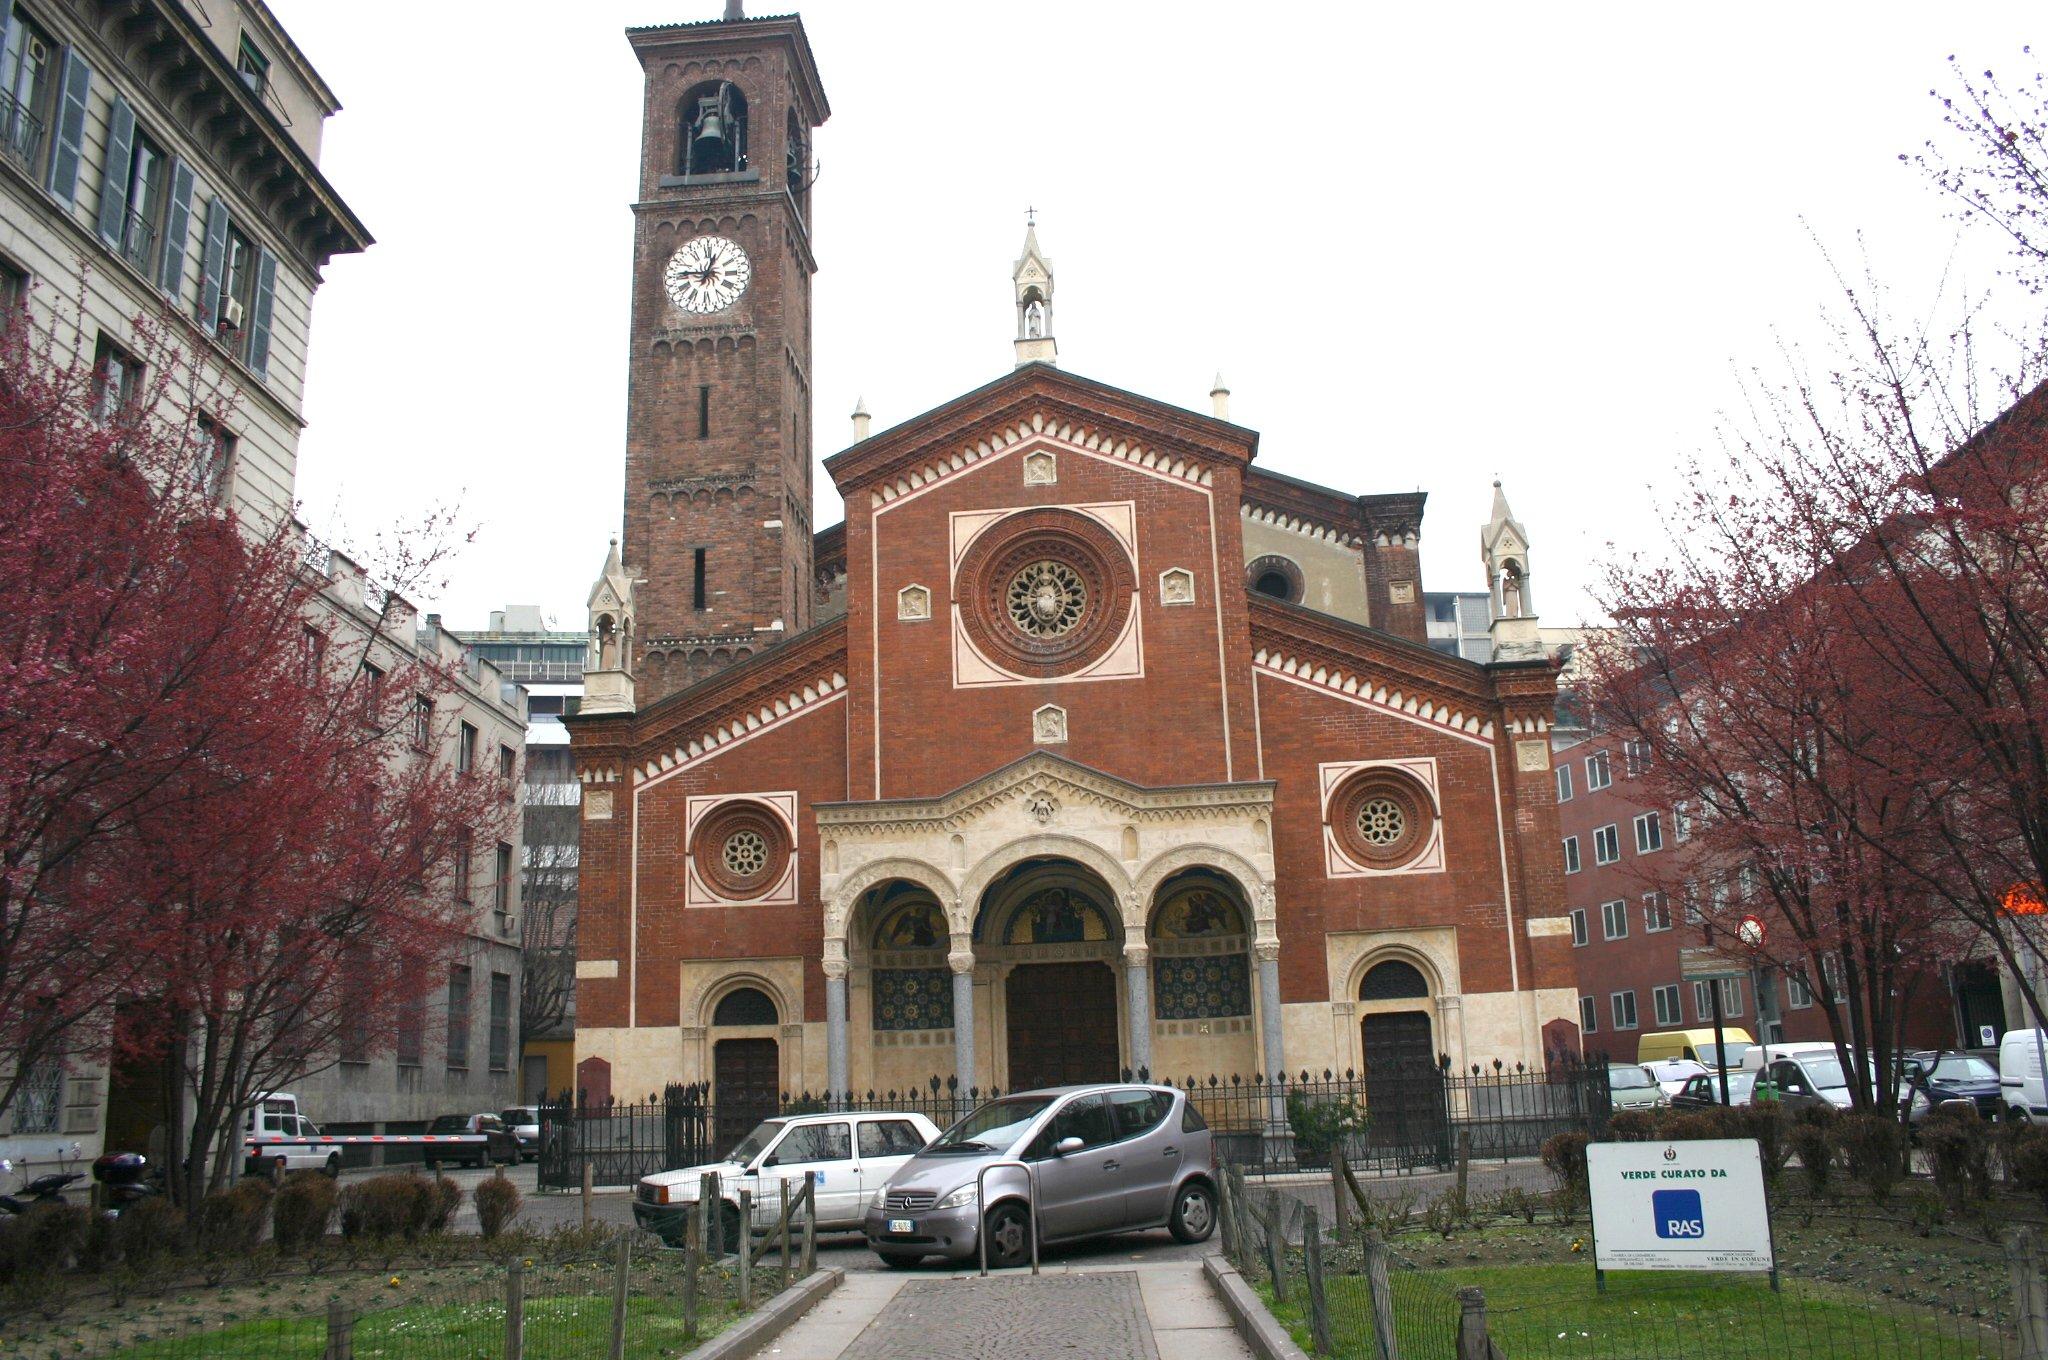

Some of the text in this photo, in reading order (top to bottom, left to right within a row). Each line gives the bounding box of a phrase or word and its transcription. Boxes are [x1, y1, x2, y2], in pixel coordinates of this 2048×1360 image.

[1621, 1169, 1727, 1179] VERDE CURATO DA
[1668, 1220, 1702, 1236] RAS
